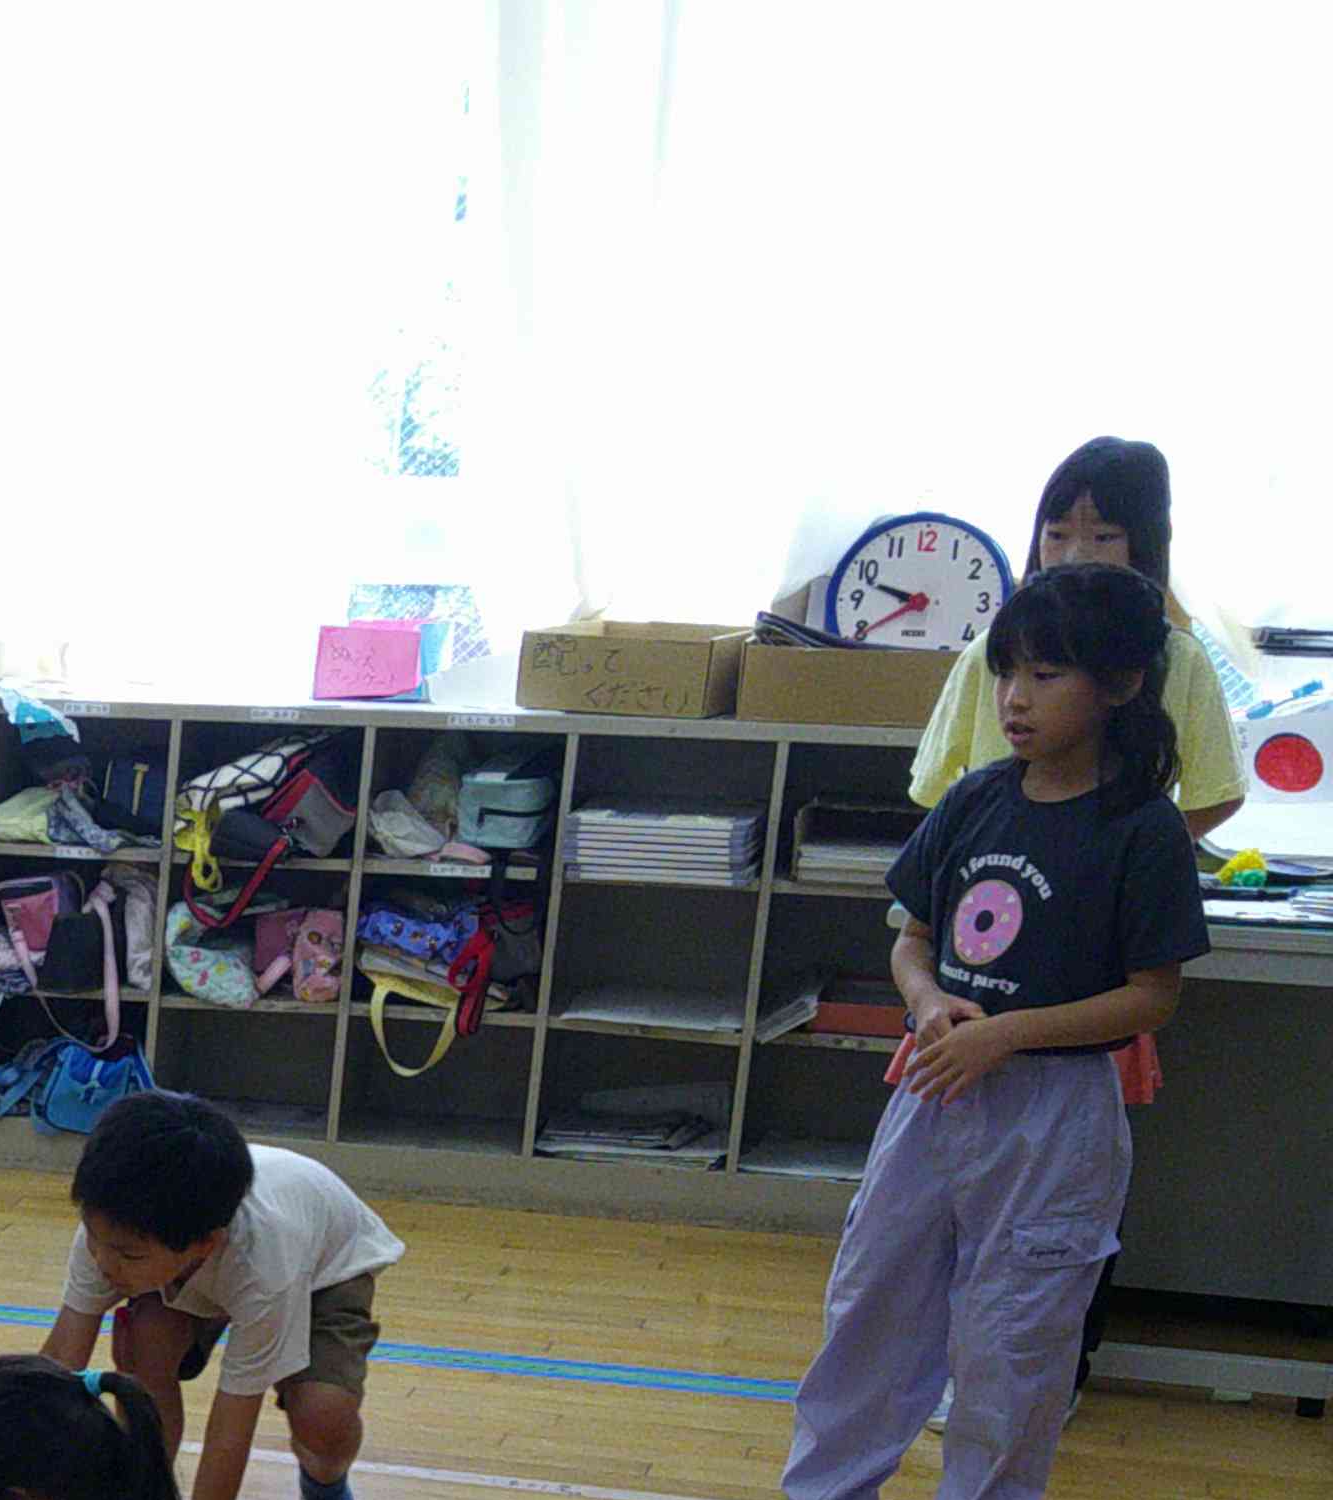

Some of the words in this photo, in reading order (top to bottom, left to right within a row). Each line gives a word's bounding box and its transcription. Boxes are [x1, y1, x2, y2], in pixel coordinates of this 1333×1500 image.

[888, 536, 904, 558] 11
[917, 529, 938, 552] 12
[951, 539, 959, 560] 1
[859, 559, 880, 583] 10
[967, 558, 983, 580] 2
[850, 589, 865, 610] 9
[976, 592, 990, 613] 3
[854, 620, 869, 641] 8
[962, 623, 975, 641] 4
[968, 853, 1027, 874] found
[1020, 863, 1053, 900] you
